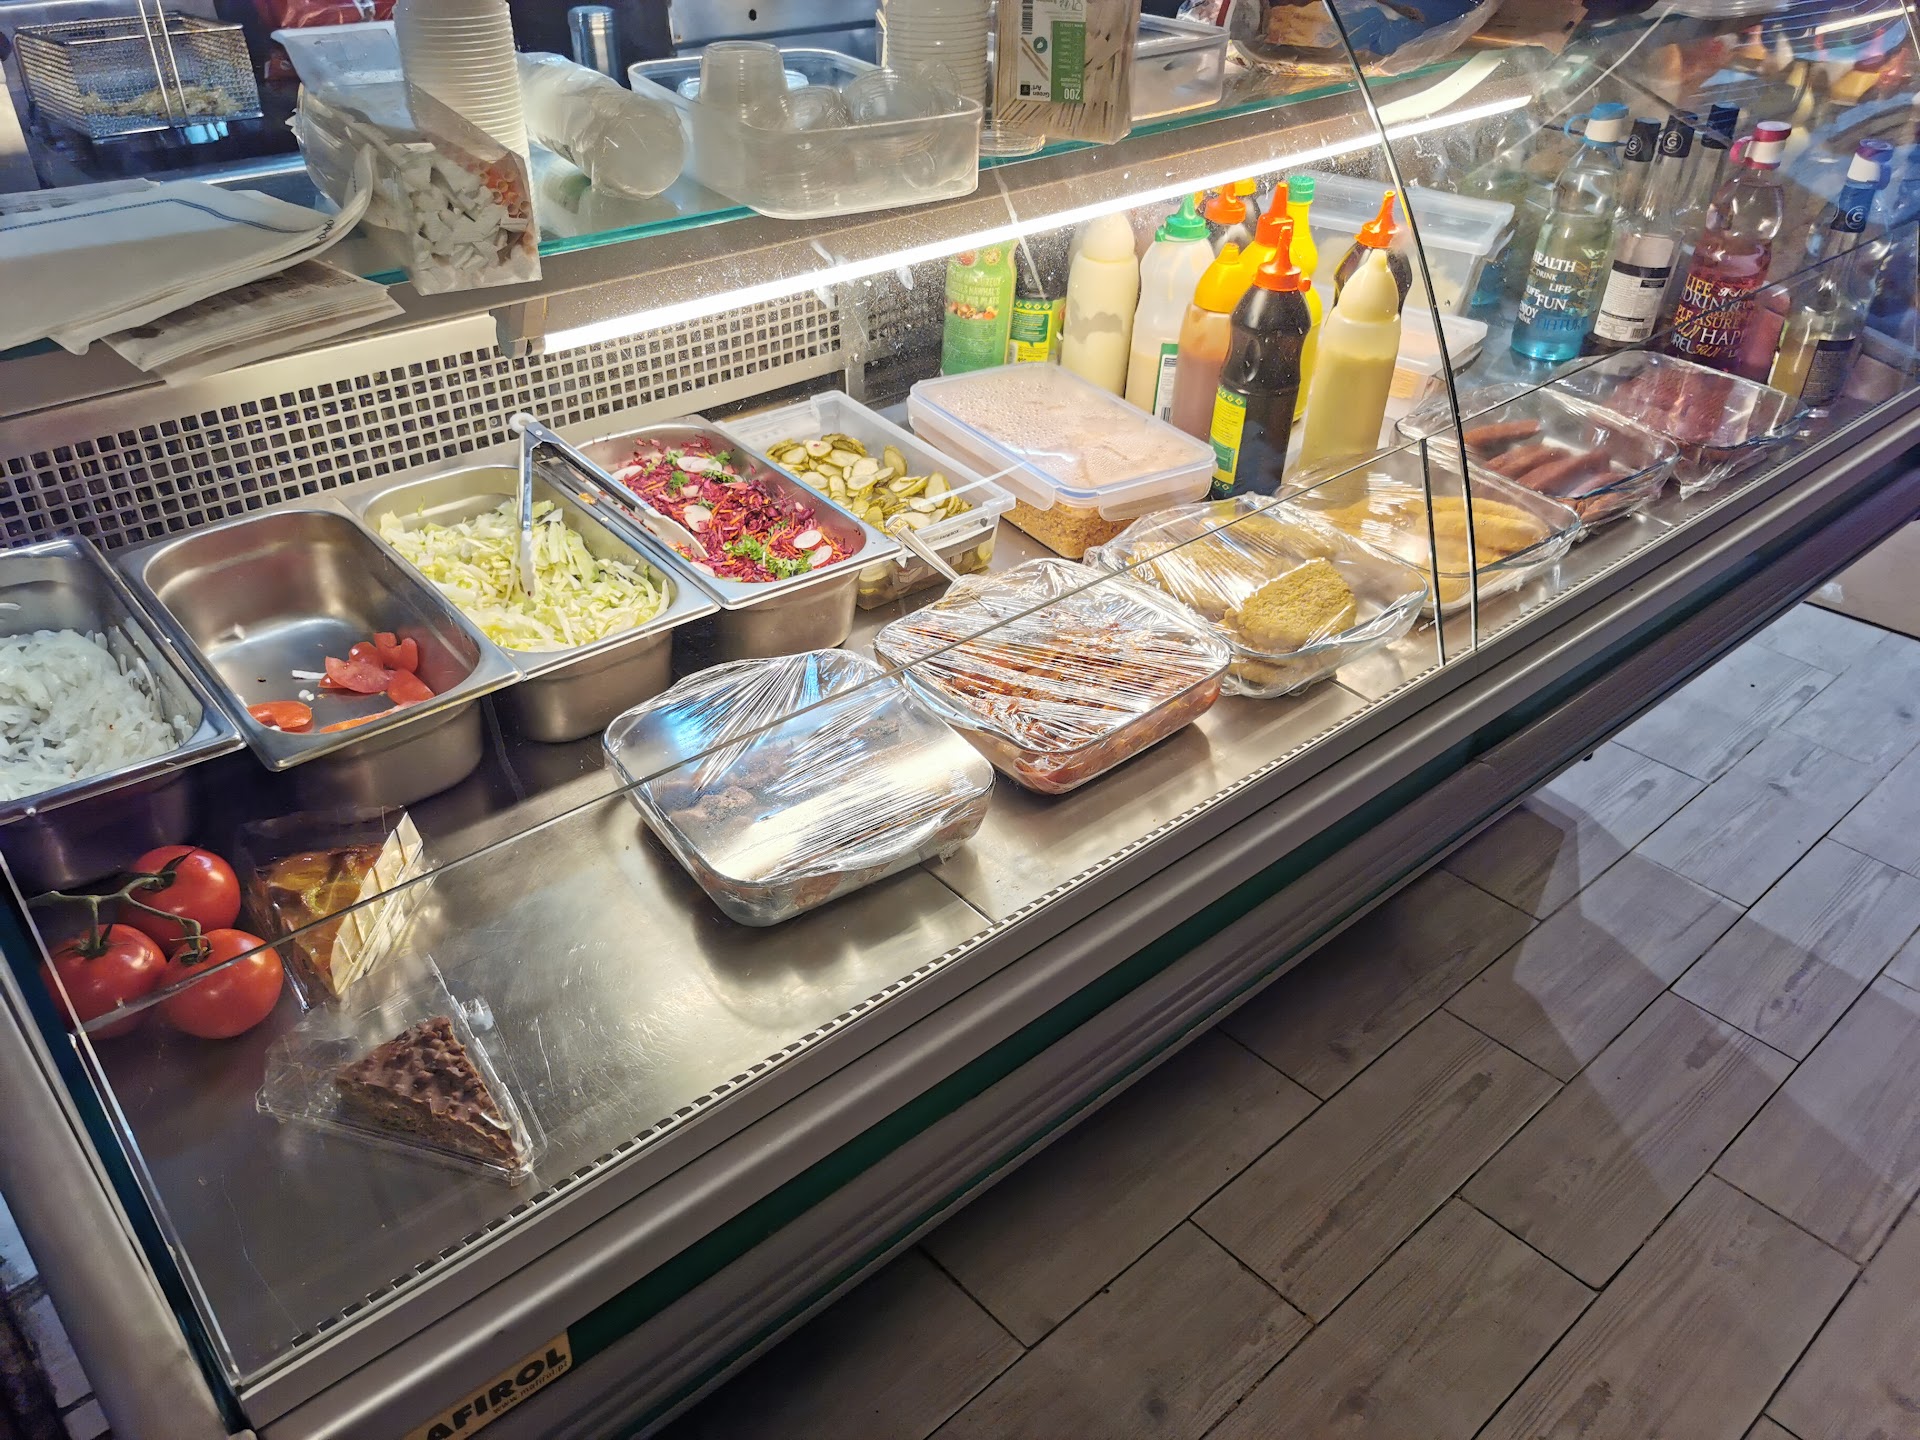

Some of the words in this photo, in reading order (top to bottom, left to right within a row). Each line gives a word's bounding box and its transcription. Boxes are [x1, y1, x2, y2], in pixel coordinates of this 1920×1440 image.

[1064, 88, 1081, 100] 200
[1533, 250, 1577, 273] HEALTH
[1549, 283, 1572, 294] LIFE
[1685, 273, 1714, 298] LIFE
[1535, 293, 1568, 311] FUN
